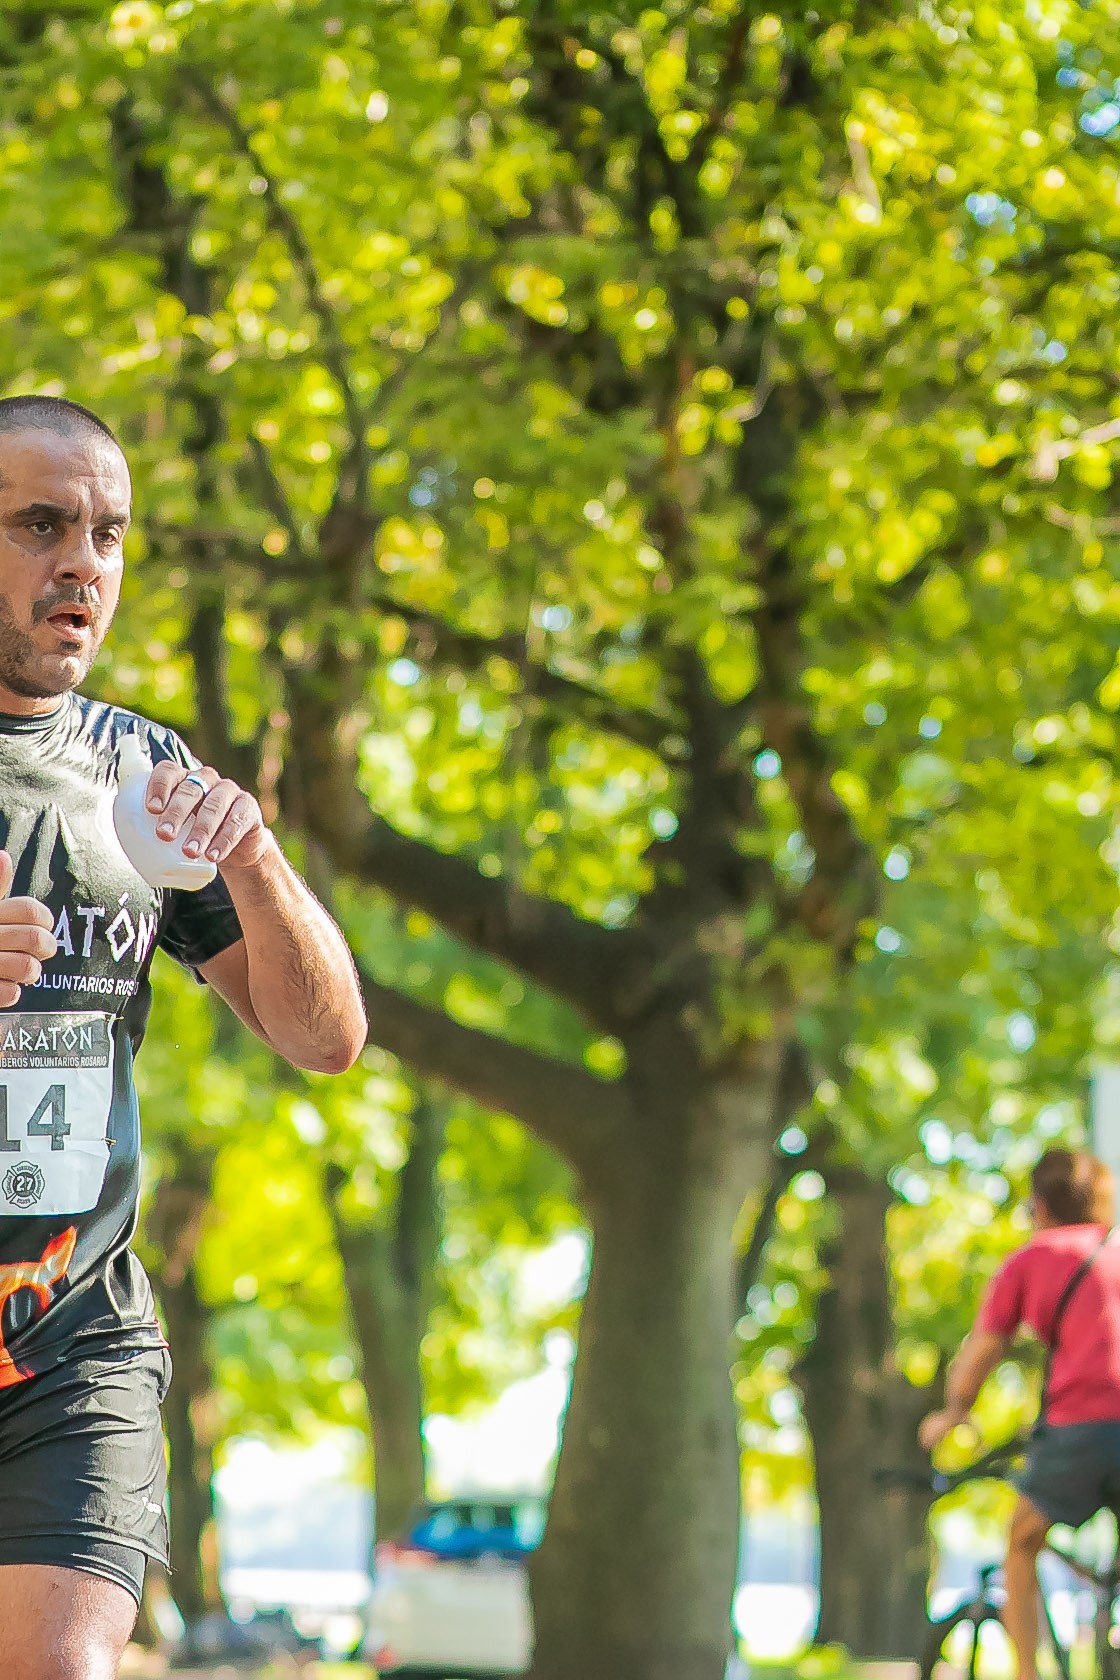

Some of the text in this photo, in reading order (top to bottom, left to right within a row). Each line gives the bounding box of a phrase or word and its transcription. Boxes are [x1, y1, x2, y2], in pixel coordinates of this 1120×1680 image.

[24, 973, 114, 995] OLUNTARIOS
[29, 1056, 80, 1068] VOLUNTARIOS
[80, 1055, 107, 1067] ROSARIO
[16, 1175, 34, 1192] 27
